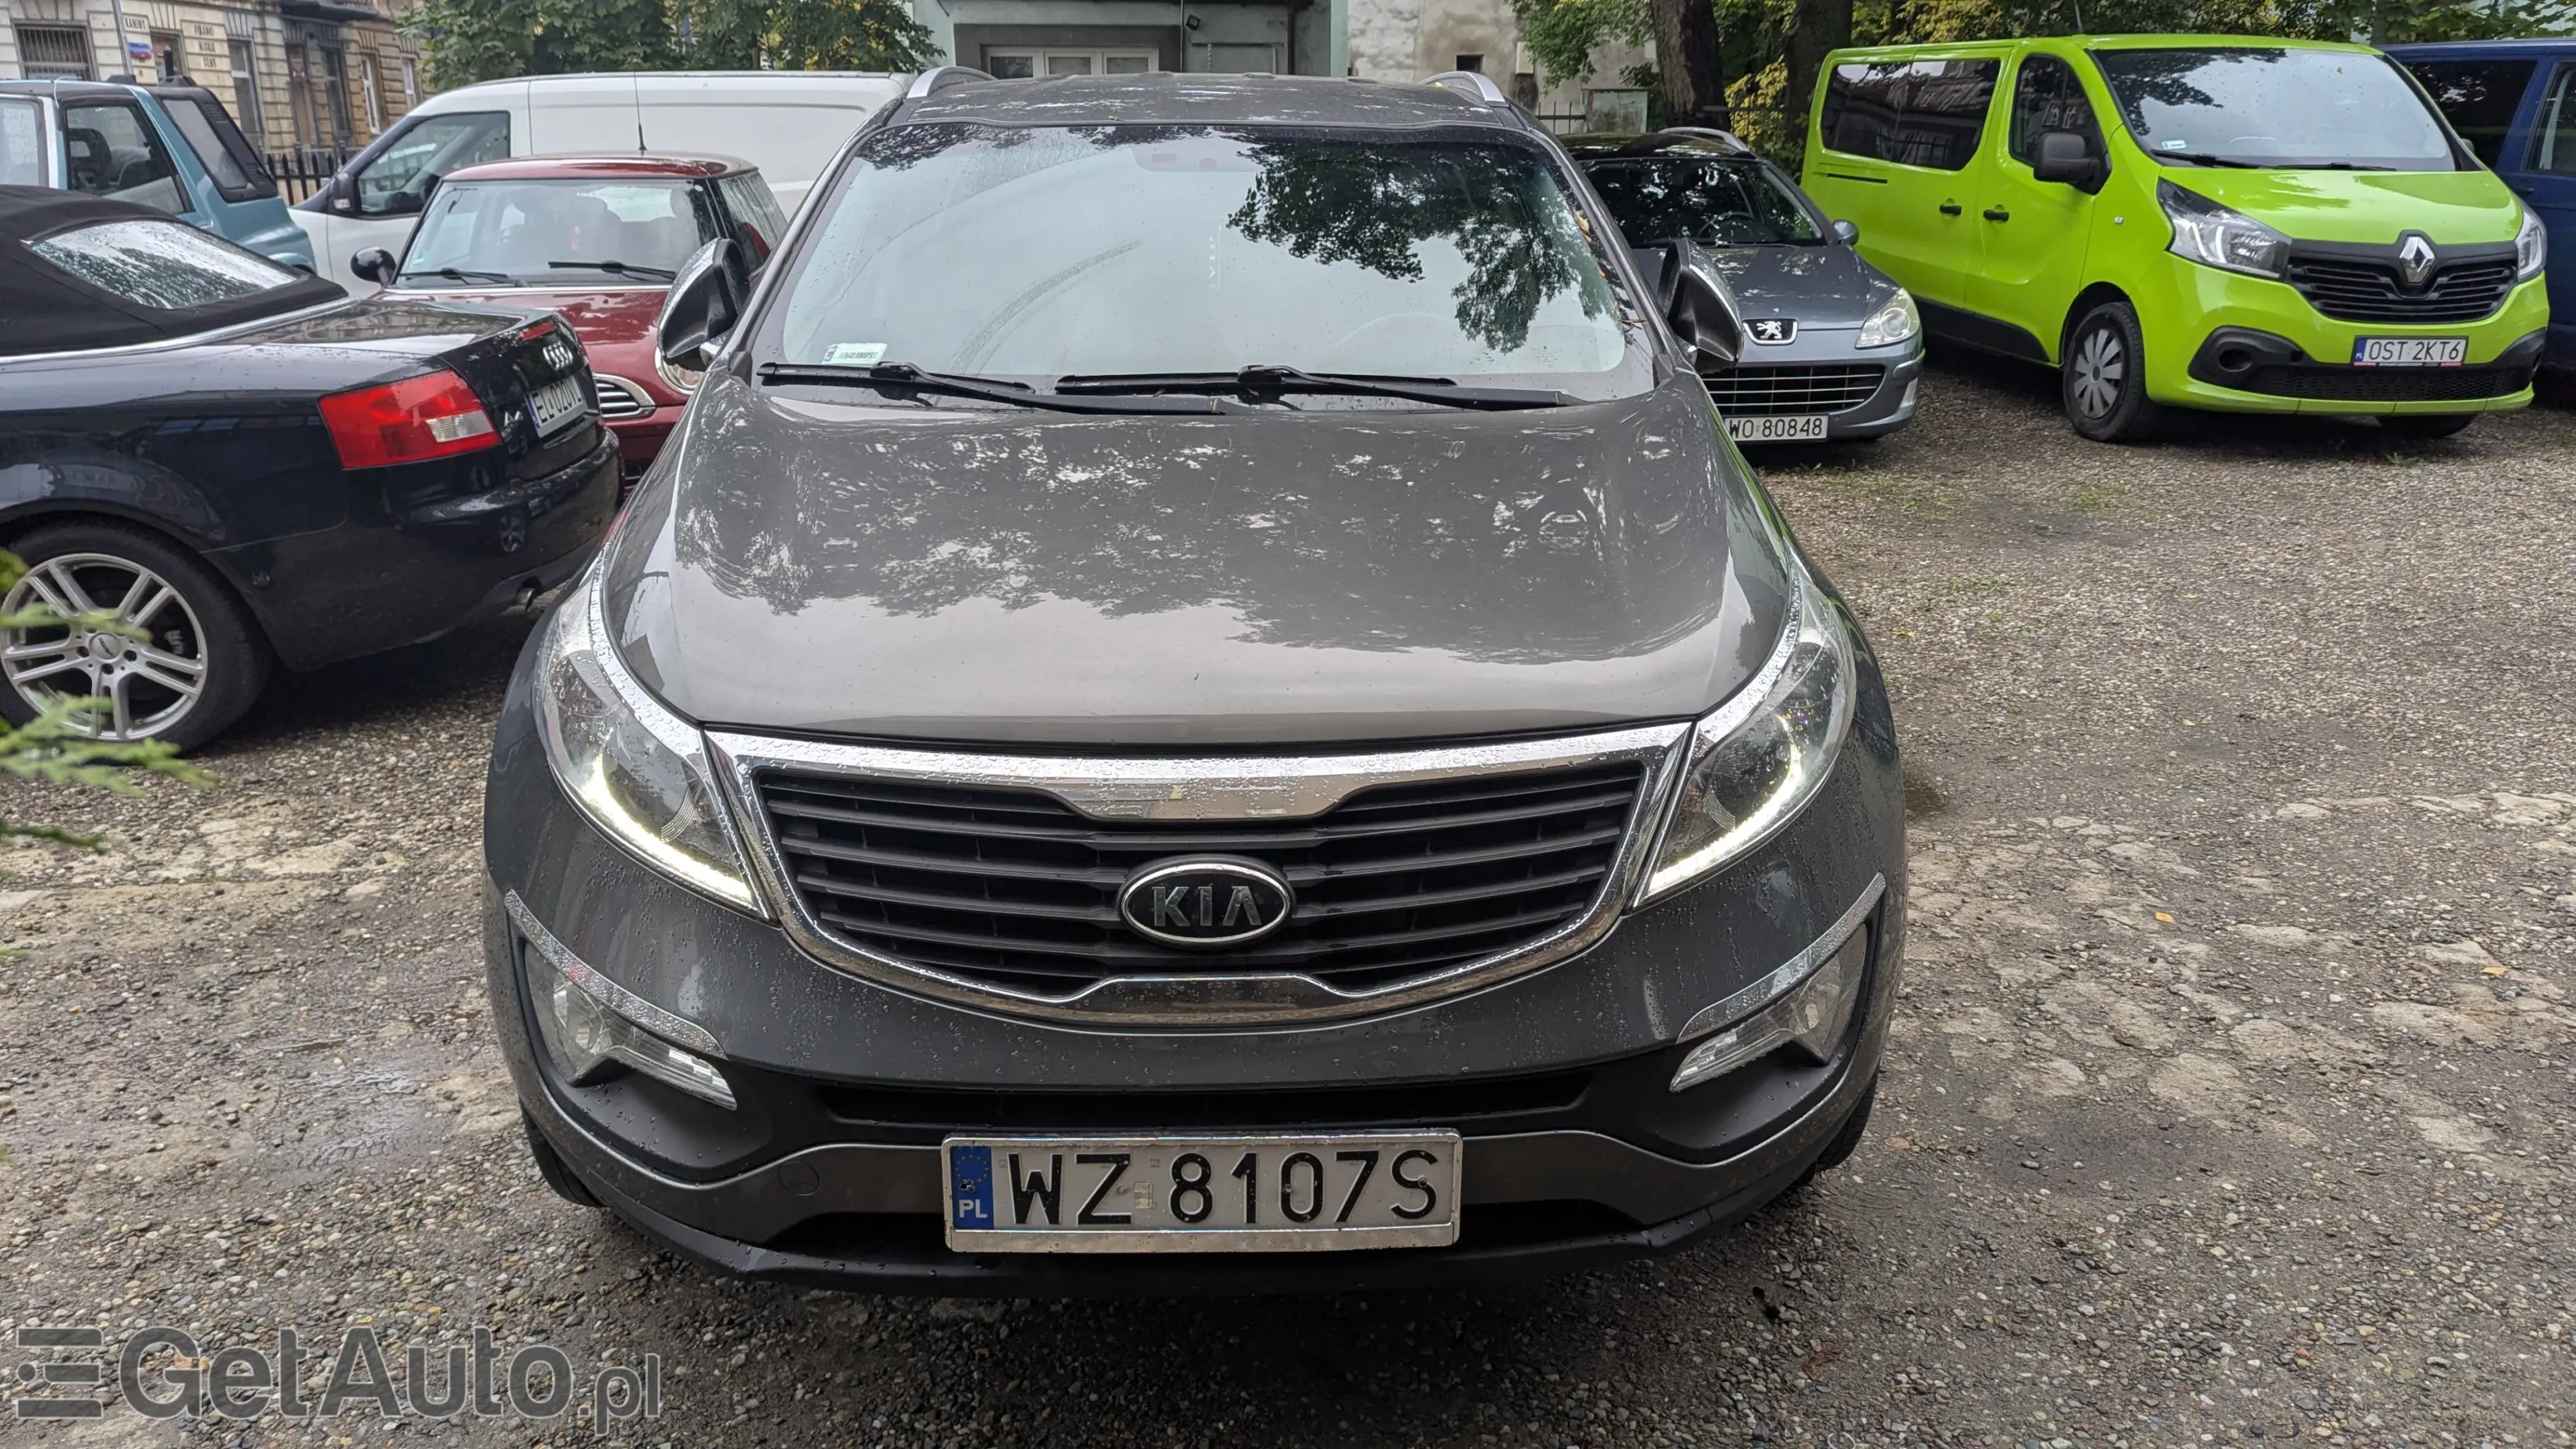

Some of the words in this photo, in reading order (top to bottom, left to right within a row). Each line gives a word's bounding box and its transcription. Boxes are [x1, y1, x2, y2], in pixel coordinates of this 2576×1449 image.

[2369, 341, 2408, 360] OST
[2411, 341, 2461, 360] 2KT6
[532, 391, 555, 424] EL
[1729, 419, 1754, 438] WO
[1761, 417, 1823, 437] 80848
[1152, 885, 1262, 927] KIA
[958, 1199, 988, 1219] PL
[1007, 1152, 1132, 1226] WZ
[1168, 1150, 1440, 1225] 8107S
